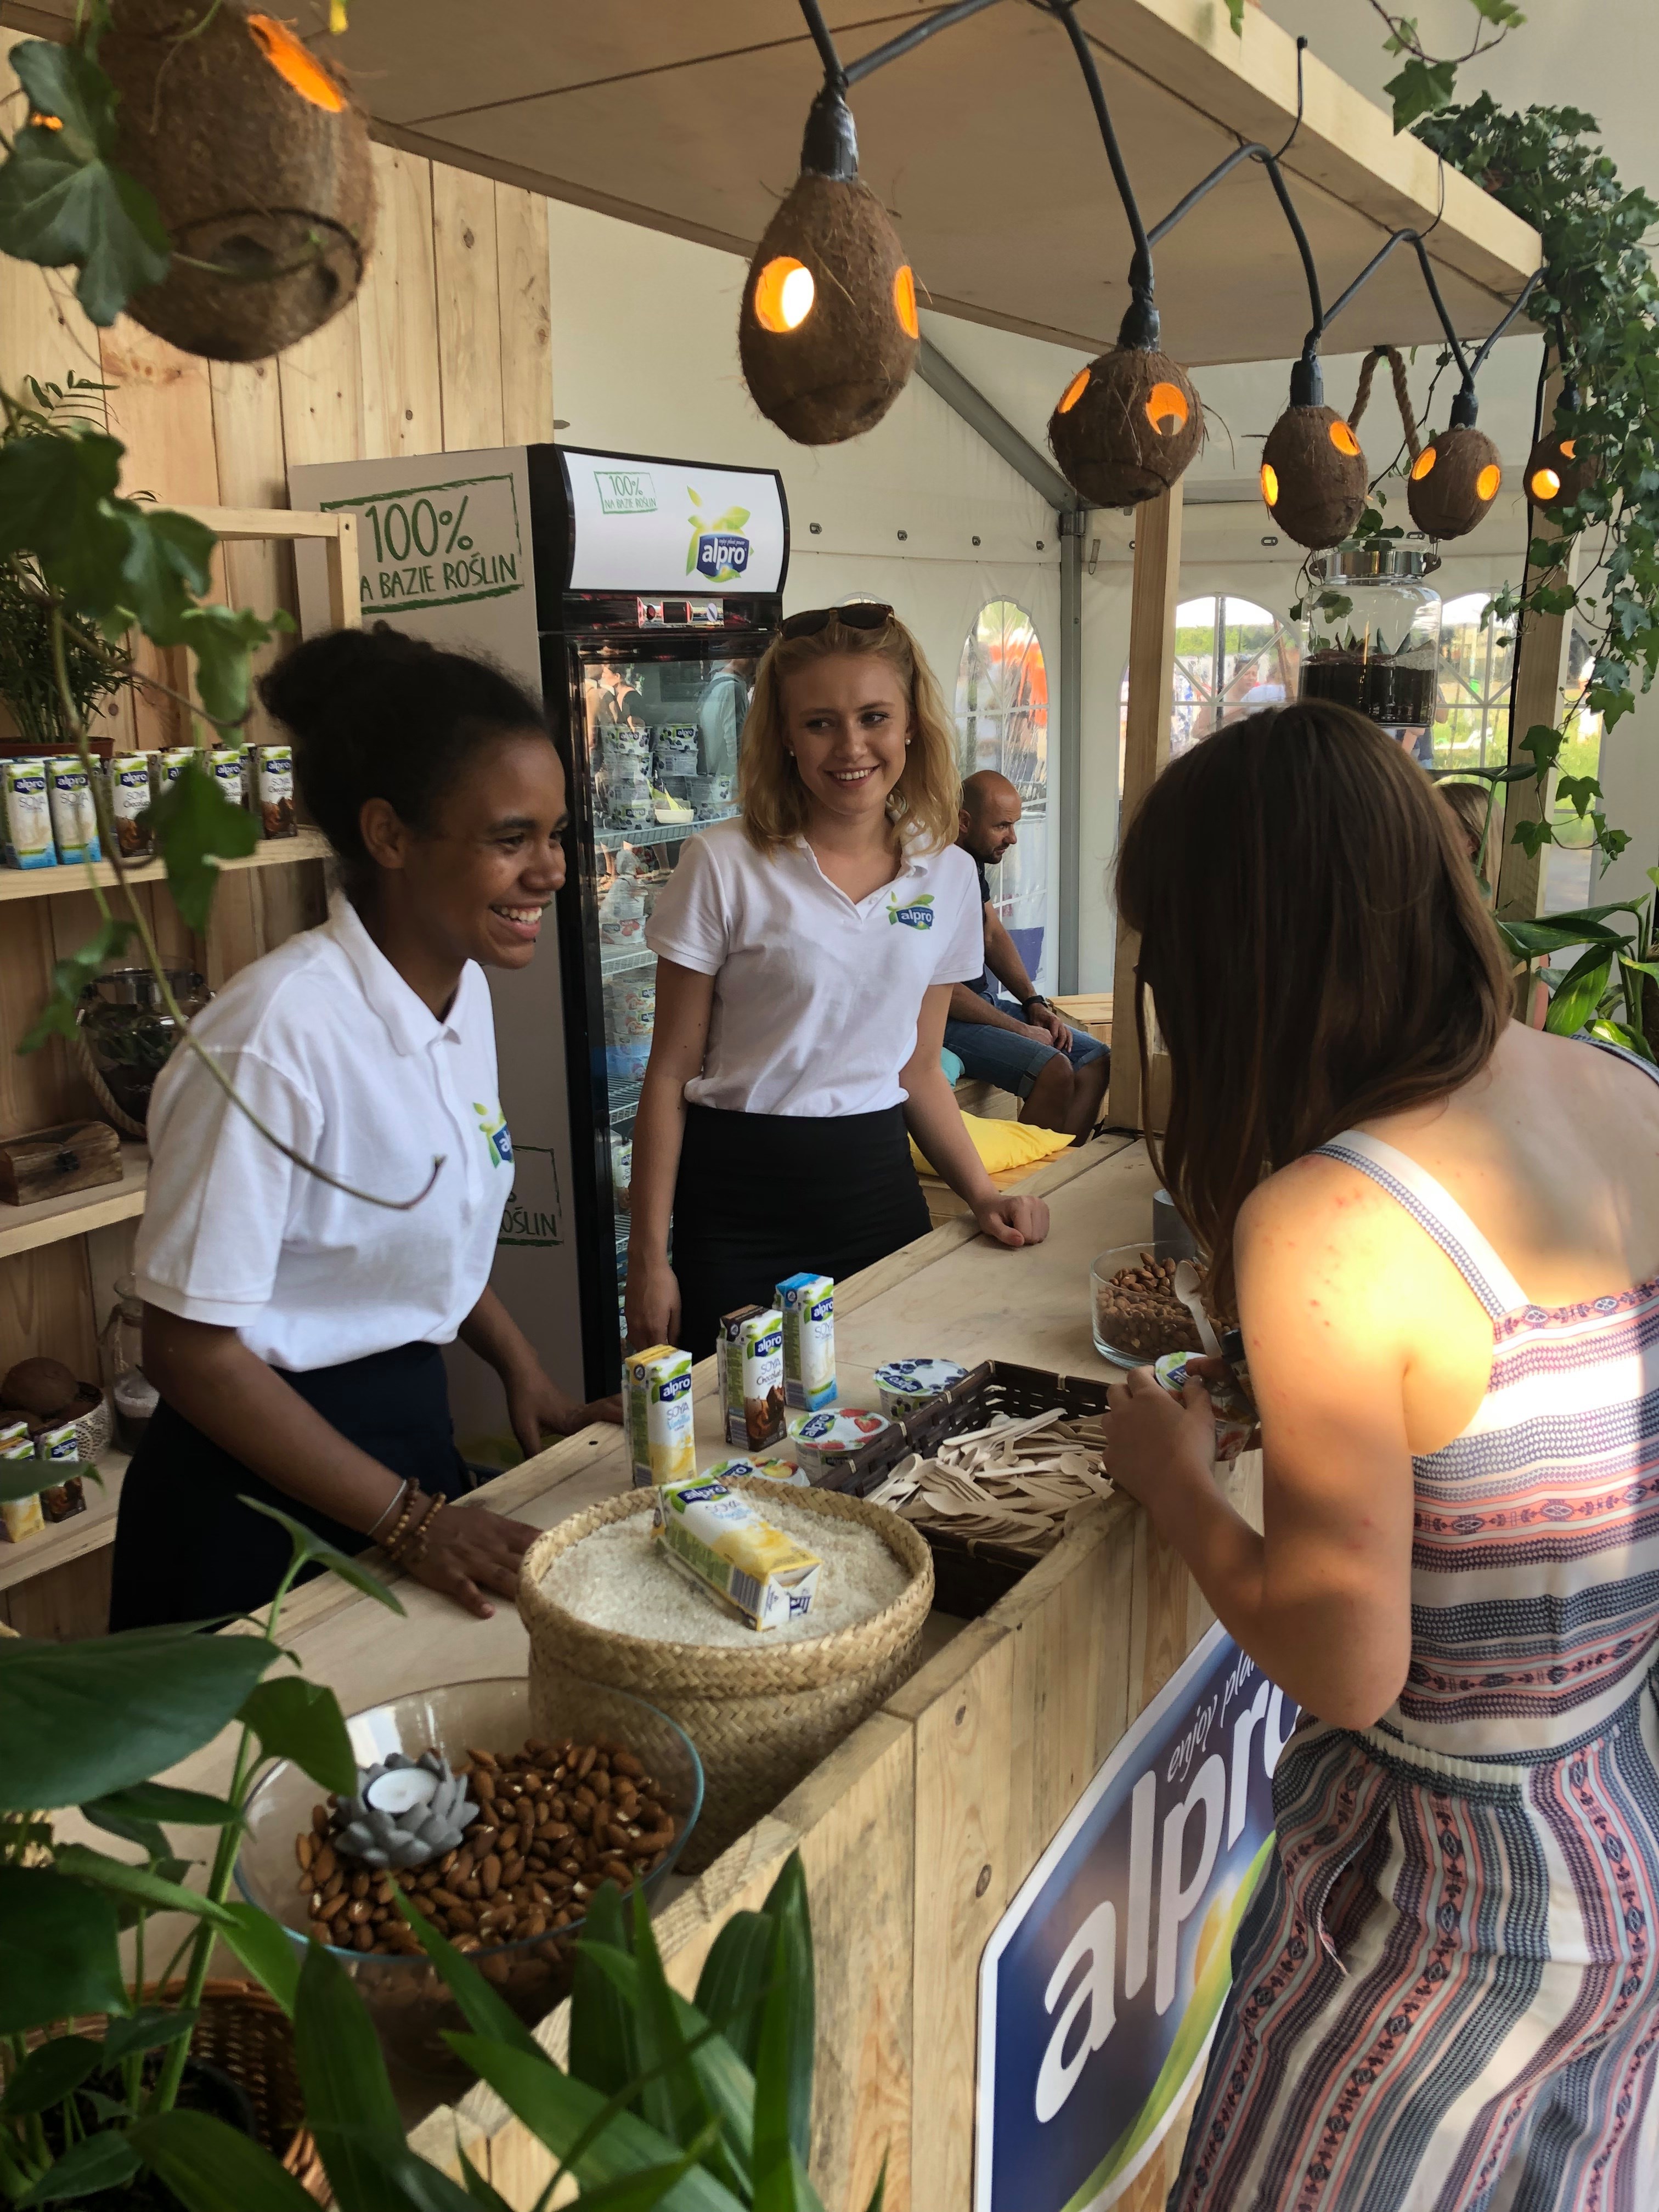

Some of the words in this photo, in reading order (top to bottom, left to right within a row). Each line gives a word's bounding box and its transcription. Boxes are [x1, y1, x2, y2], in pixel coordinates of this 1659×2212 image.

[609, 476, 643, 496] 100%
[605, 499, 614, 509] NA
[364, 495, 474, 563] 100%
[702, 537, 745, 571] alpro
[379, 565, 437, 600] BAZIE
[442, 551, 517, 591] ROŚLIN
[217, 764, 241, 775] alpro
[268, 760, 291, 771] alpro
[16, 778, 45, 792] alpro
[57, 775, 86, 787] alpro
[122, 772, 148, 785] alpro
[900, 909, 932, 924] alpro
[500, 1206, 557, 1237] OŚLIN
[757, 1335, 782, 1353] alpro
[760, 1358, 781, 1375] SOYA
[663, 1378, 691, 1398] alpro
[888, 1376, 918, 1391] alpro
[666, 1401, 690, 1421] SOYA
[805, 1414, 830, 1437] alpro
[53, 1441, 76, 1455] alpro
[683, 1485, 727, 1499] alpro
[1166, 1694, 1218, 1783] enjoy
